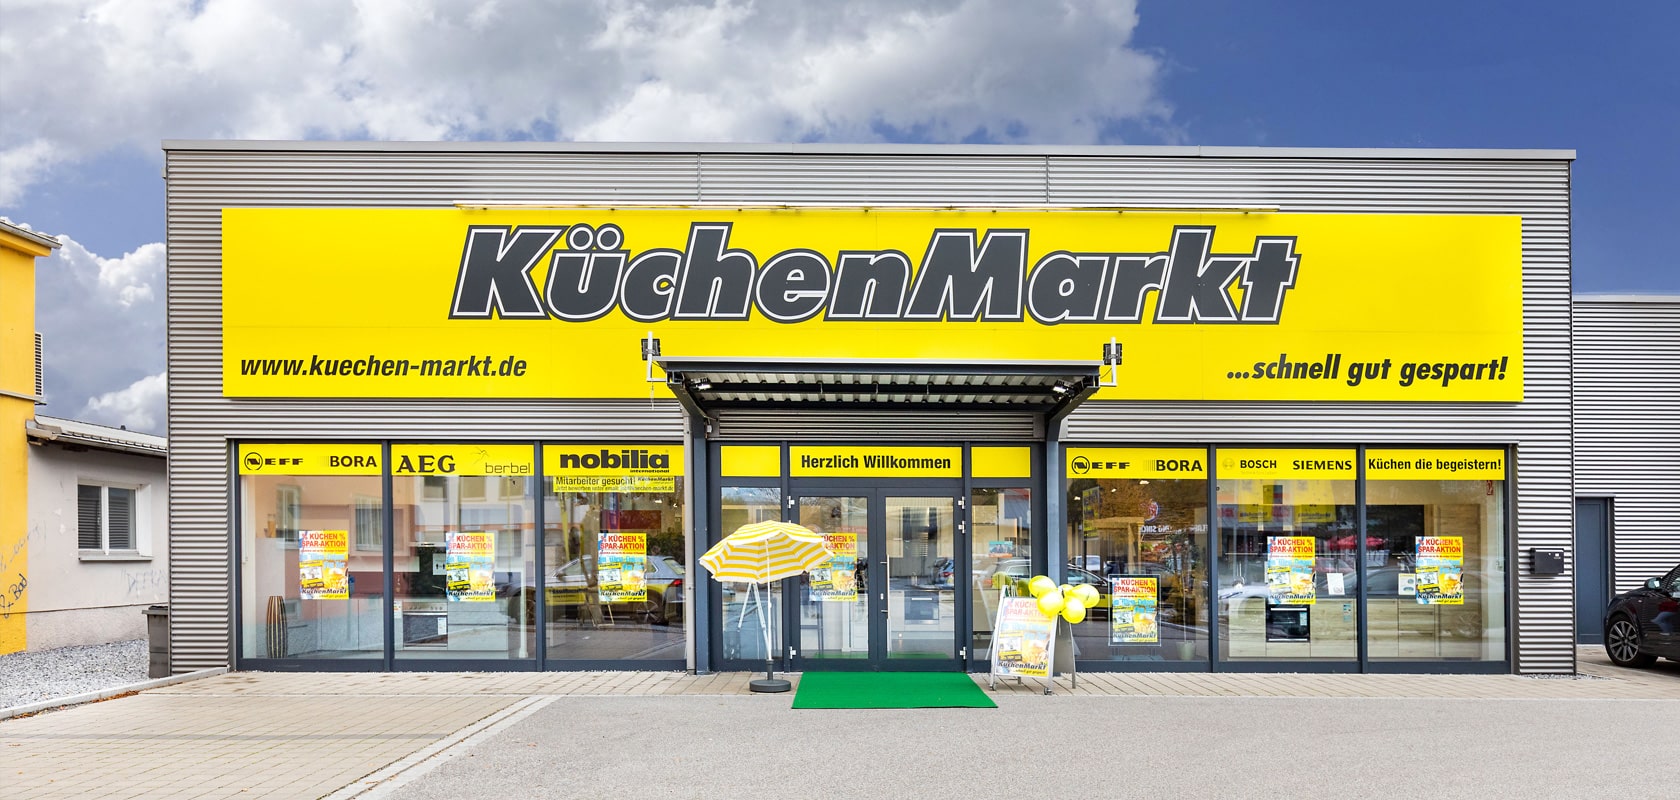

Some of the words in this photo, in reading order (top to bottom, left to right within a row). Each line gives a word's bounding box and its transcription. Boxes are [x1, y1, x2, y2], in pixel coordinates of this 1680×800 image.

[448, 222, 1302, 325] KüchenMarkt
[240, 355, 527, 377] www.kuechen-markt.de
[1227, 353, 1341, 380] ...schnell
[1347, 358, 1392, 387] gut
[1400, 356, 1508, 388] gespart!
[245, 455, 303, 468] NEFF
[330, 455, 377, 467] BORA
[396, 455, 456, 473] AEG
[560, 450, 670, 469] nobilia
[801, 455, 859, 469] Herzlich
[863, 455, 951, 469] Willkommen
[1073, 459, 1129, 472] NEFF
[1156, 460, 1203, 471] BORA
[1240, 459, 1277, 469] BOSCH
[1292, 460, 1352, 470] SIEMENS
[1368, 458, 1411, 470] Küchen
[1415, 458, 1433, 470] die
[1436, 458, 1502, 472] begeistern!
[485, 462, 531, 474] berbel
[555, 477, 599, 485] Mitarbeiter
[601, 477, 635, 486] gesucht!
